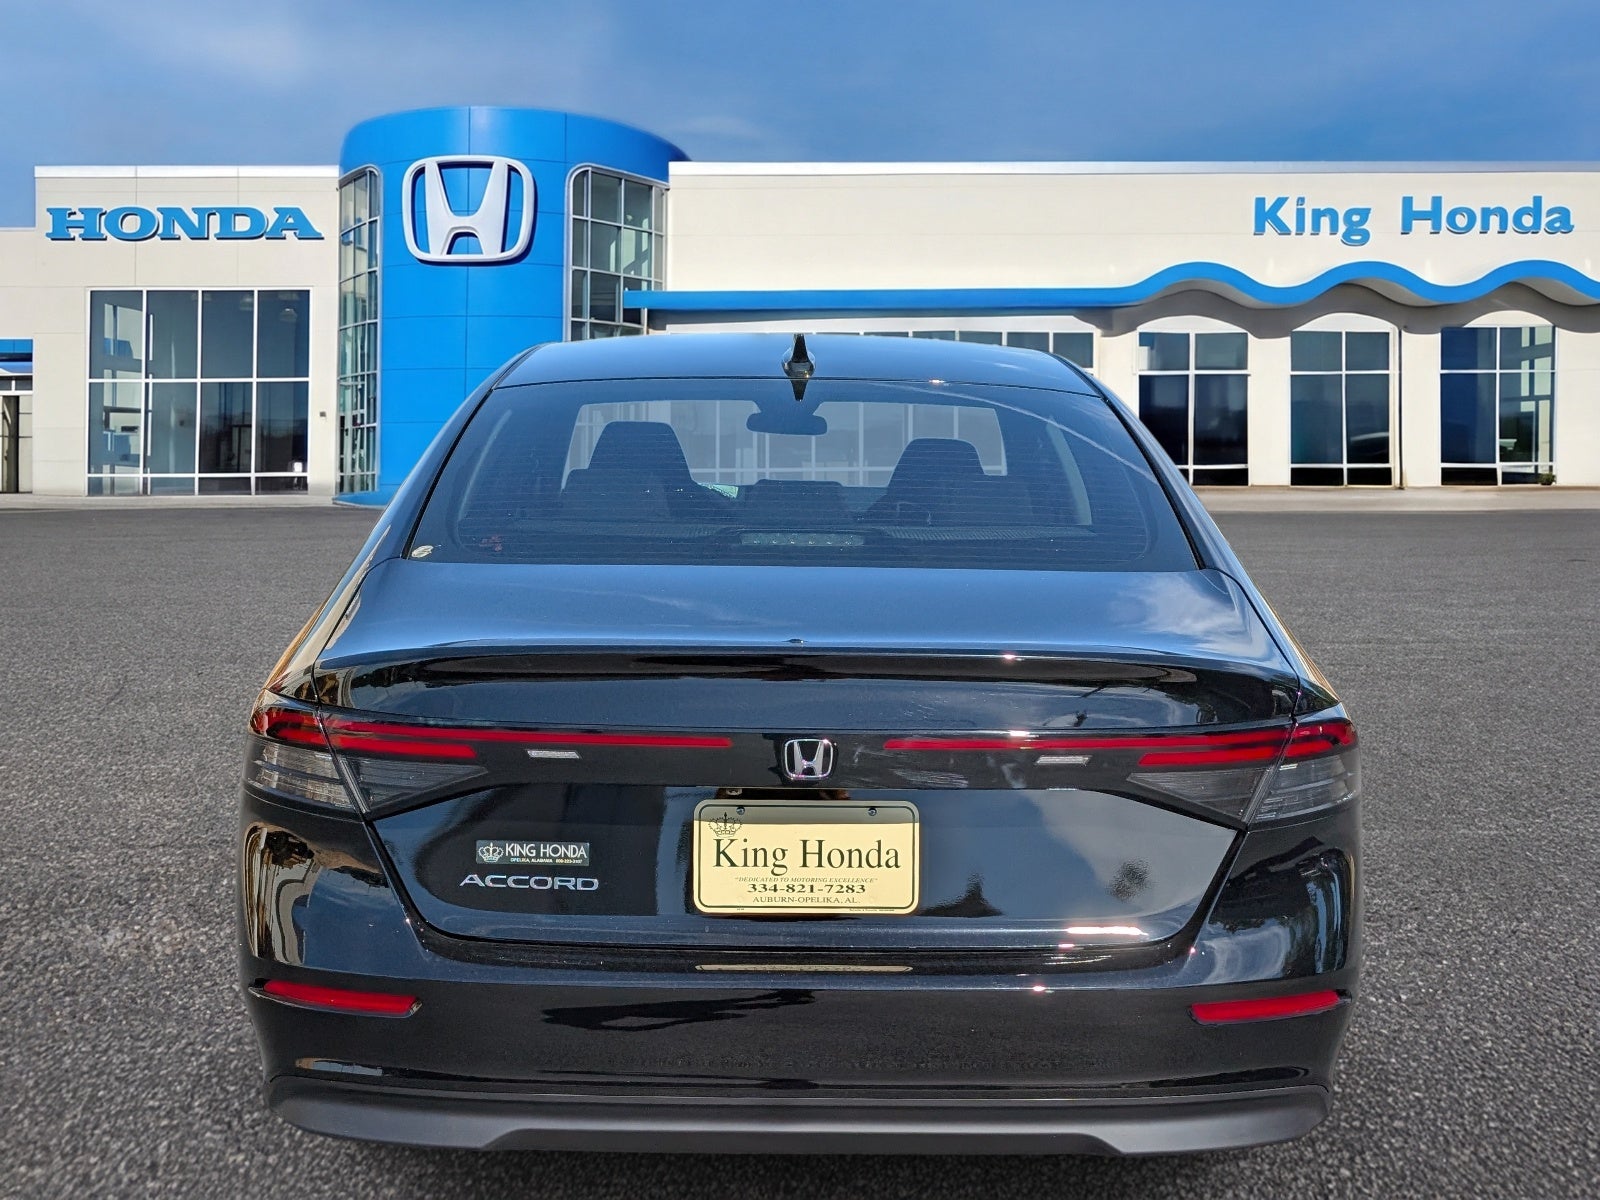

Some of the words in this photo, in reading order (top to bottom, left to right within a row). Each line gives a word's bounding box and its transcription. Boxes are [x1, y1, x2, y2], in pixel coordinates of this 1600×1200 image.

[46, 206, 324, 242] HONDA
[1253, 196, 1372, 246] King
[1401, 196, 1574, 234] Honda
[505, 843, 536, 857] KING
[540, 844, 587, 858] HONDA
[712, 838, 788, 876] King
[800, 839, 901, 869] Honda
[459, 874, 599, 891] ACCORD
[747, 883, 866, 894] 334-821-7283
